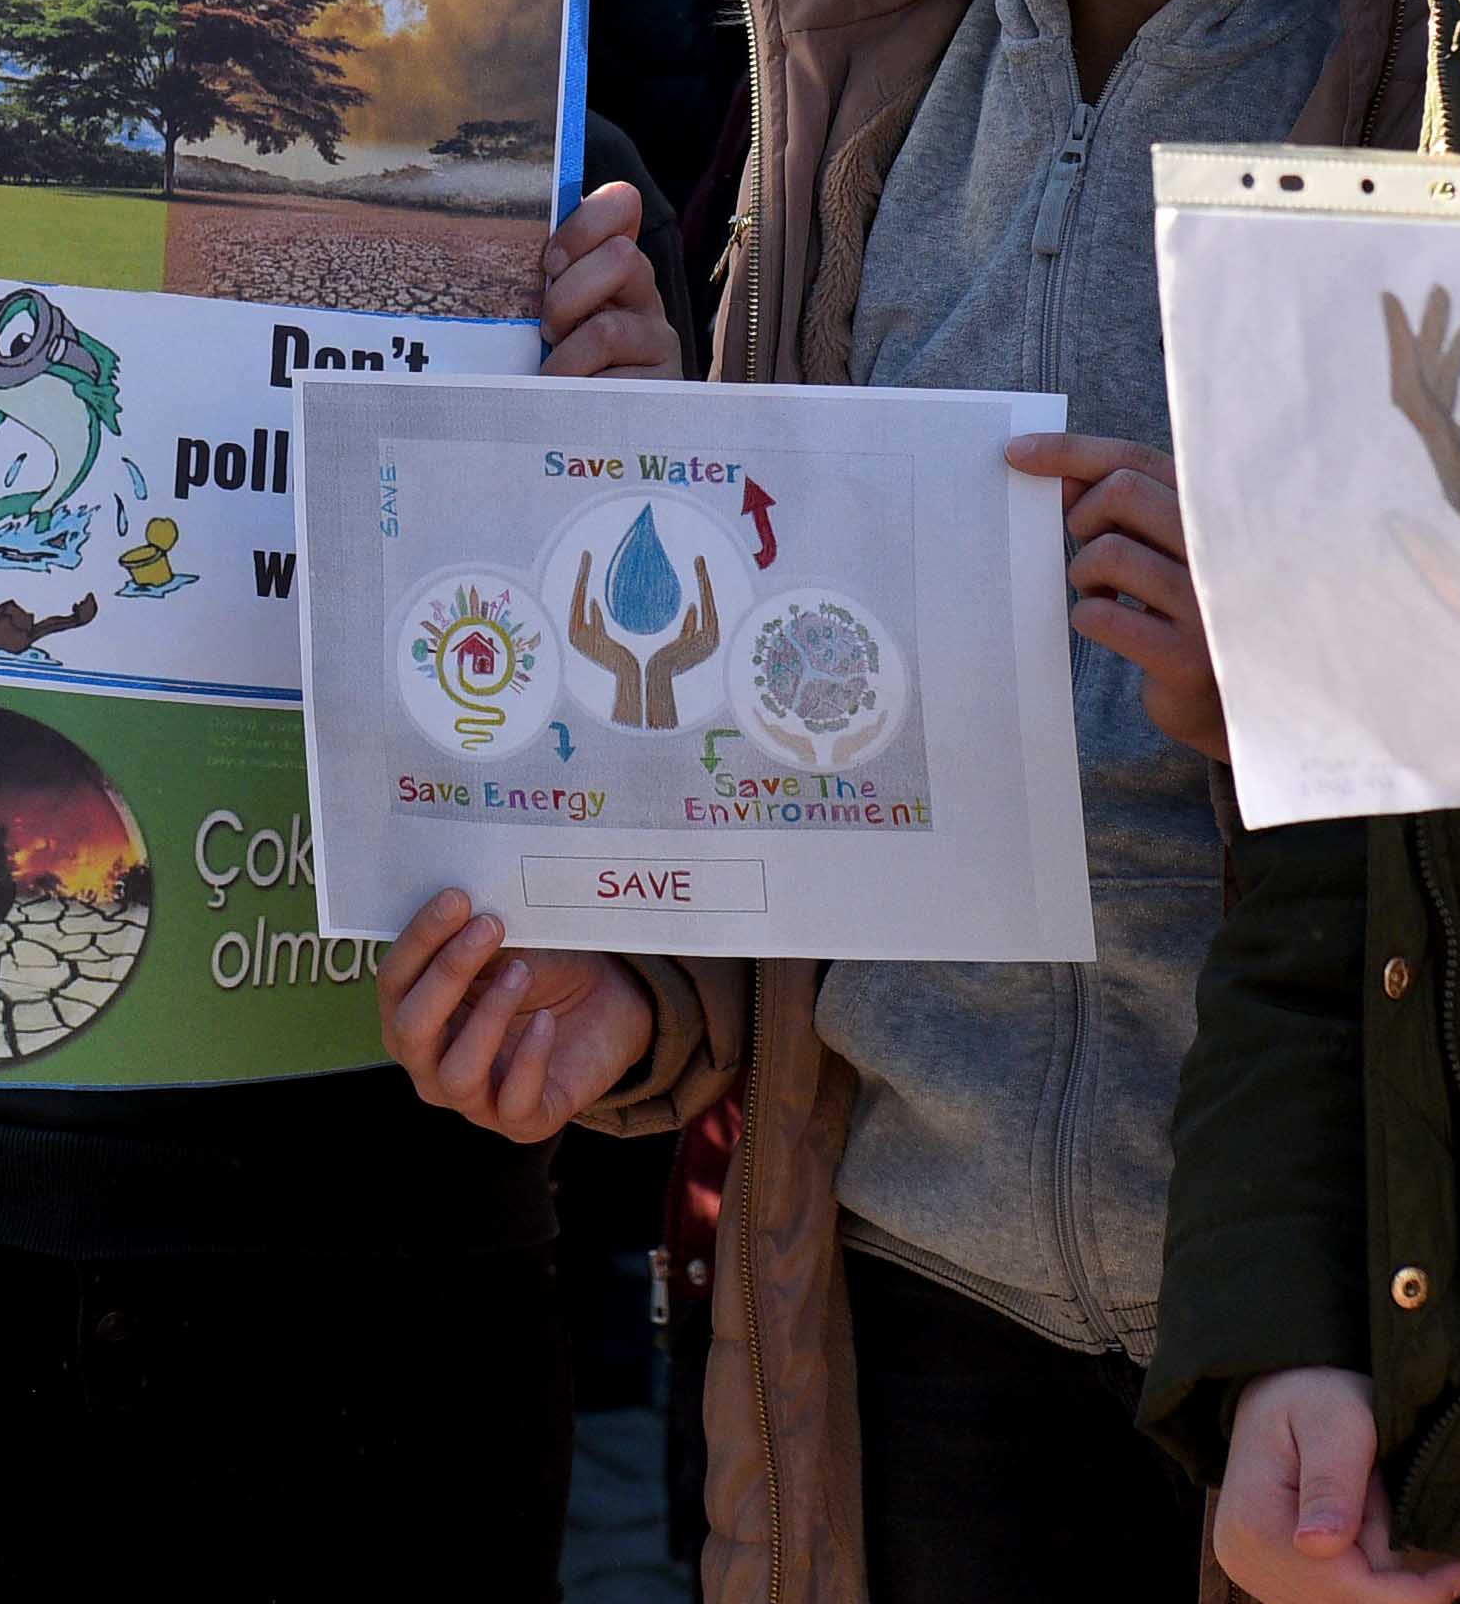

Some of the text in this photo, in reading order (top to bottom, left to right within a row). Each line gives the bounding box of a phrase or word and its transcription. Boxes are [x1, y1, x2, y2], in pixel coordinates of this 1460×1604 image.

[174, 428, 292, 500] poll
[544, 450, 742, 486] Save Water
[379, 463, 399, 538] SAVE
[398, 774, 606, 821] Save Energy
[714, 772, 877, 798] Save The
[683, 797, 932, 826] Environment
[195, 809, 315, 910] Çok
[596, 869, 692, 902] SAVE
